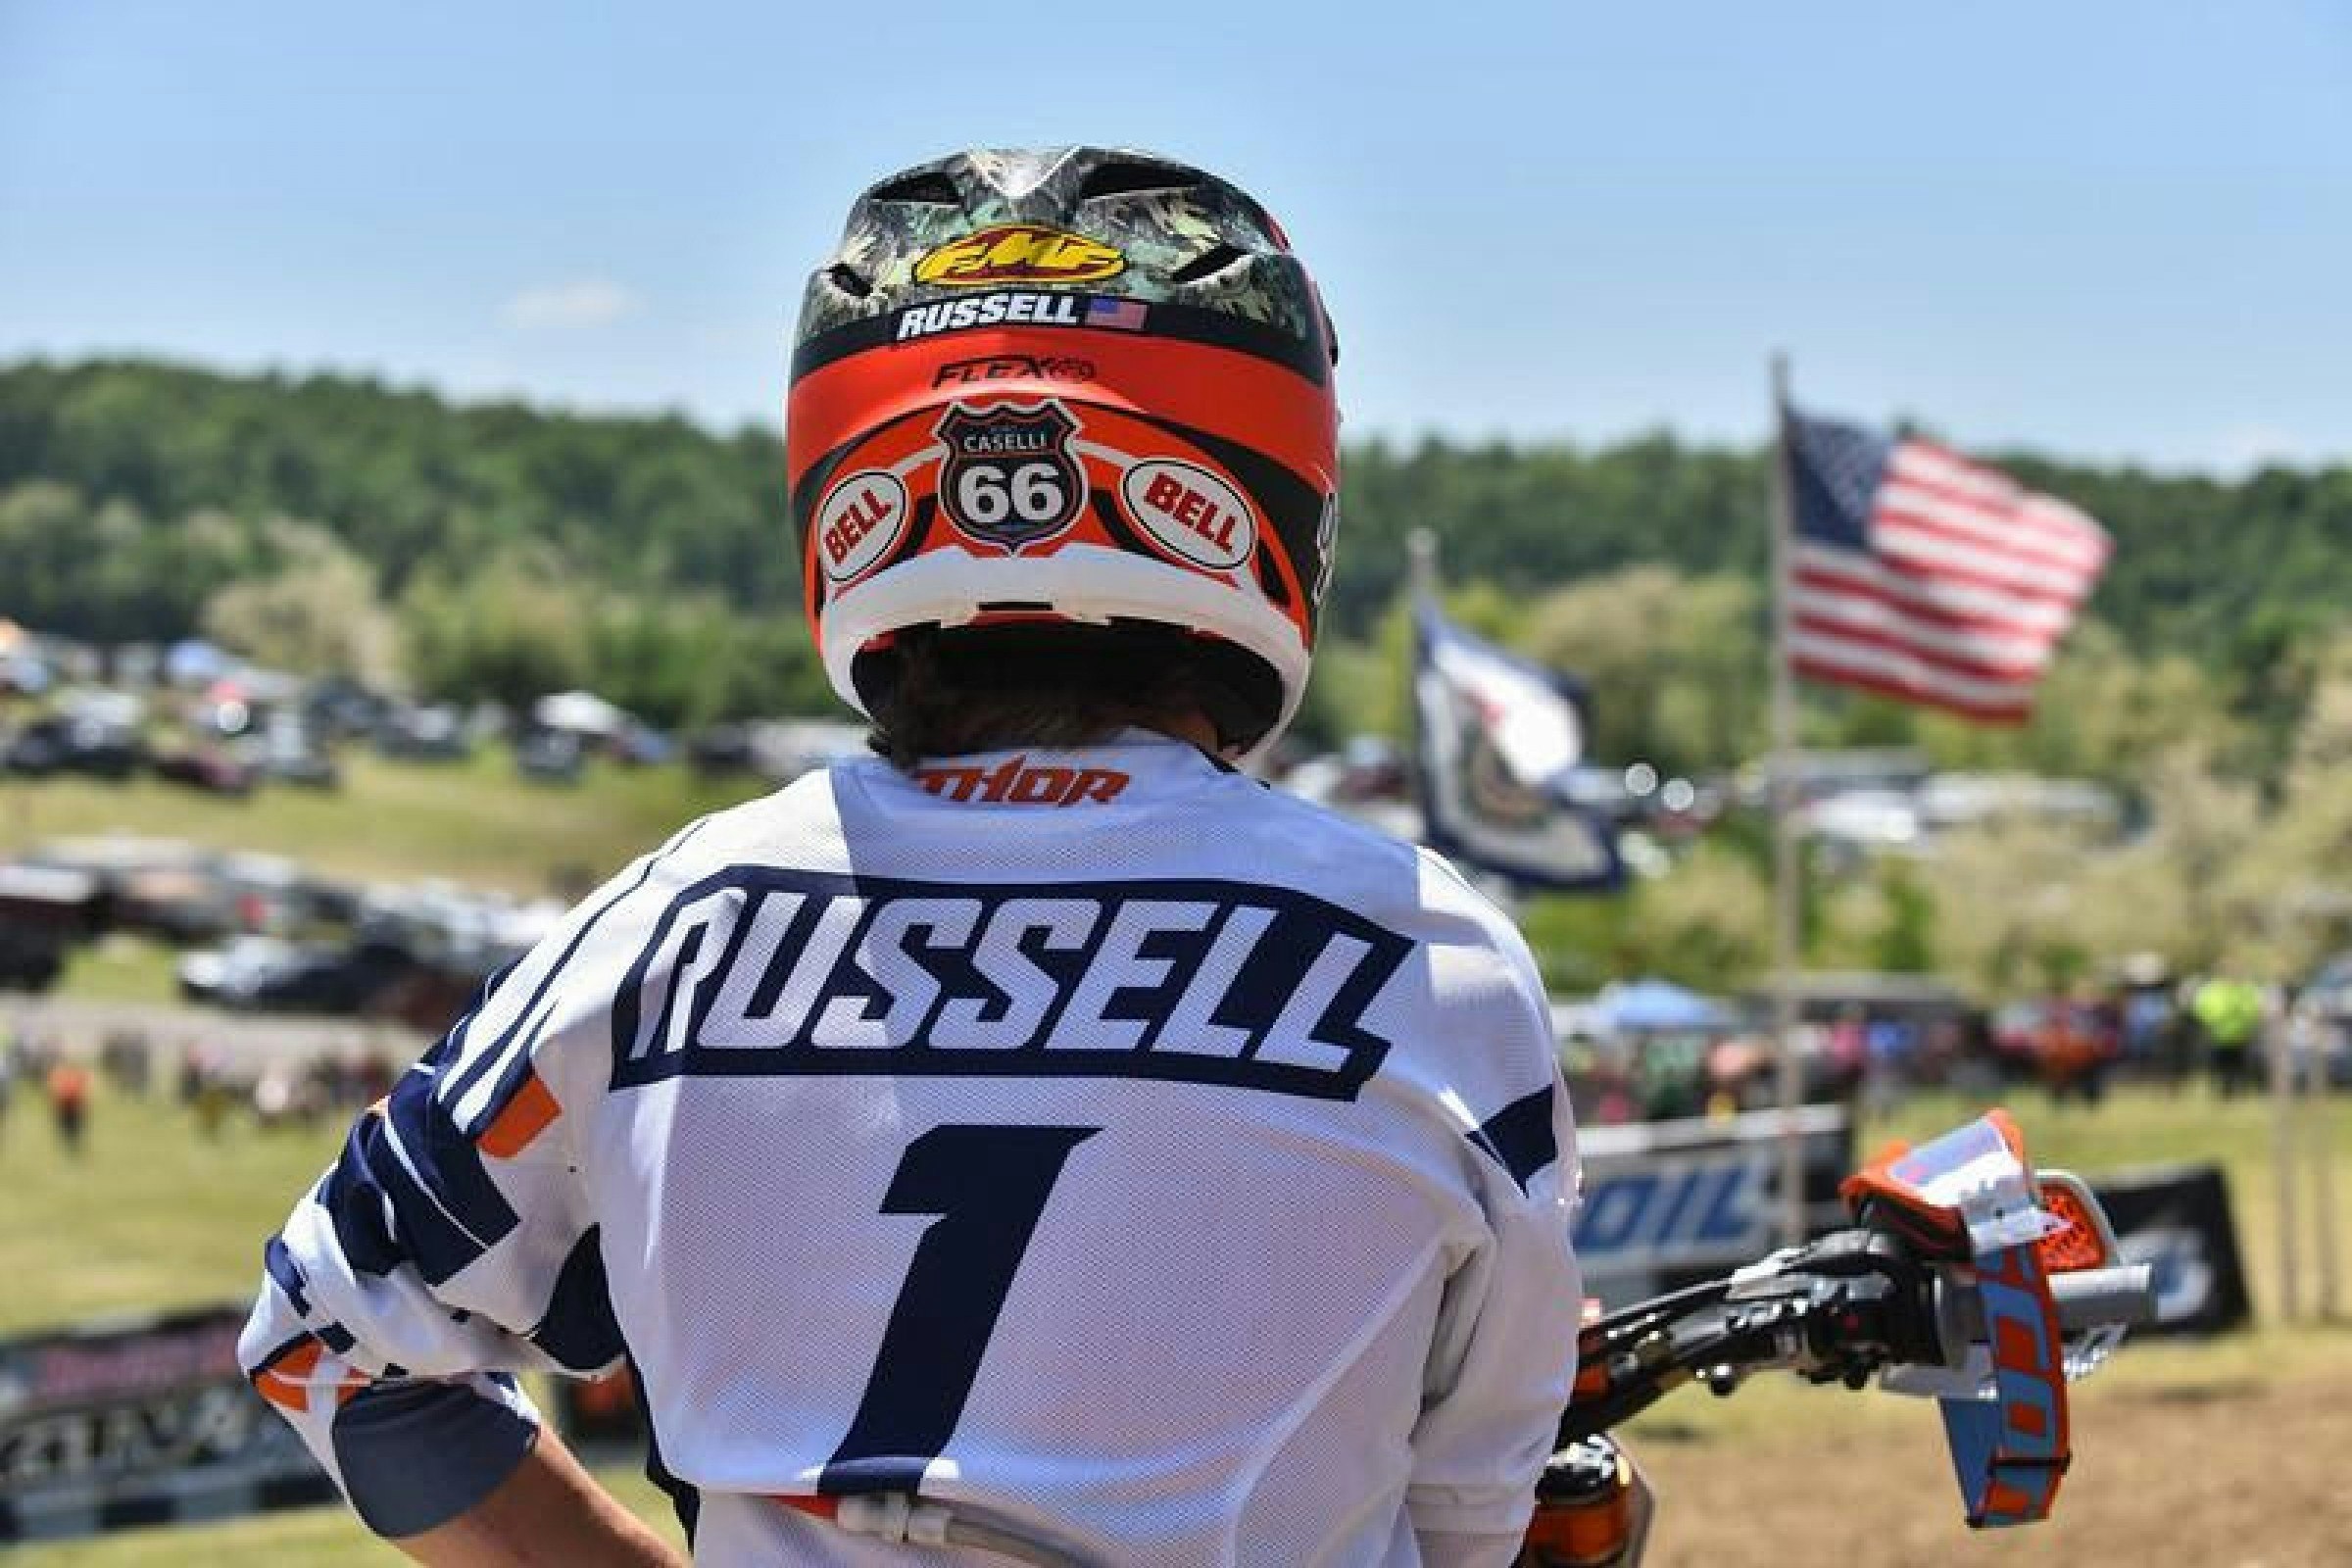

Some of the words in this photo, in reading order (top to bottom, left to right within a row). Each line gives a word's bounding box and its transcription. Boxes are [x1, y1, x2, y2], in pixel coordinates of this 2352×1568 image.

[896, 293, 1079, 341] RUSSELL
[963, 431, 1048, 452] CASELLI
[957, 463, 1065, 523] 66
[1143, 470, 1238, 554] BELL
[825, 489, 893, 566] BELL
[911, 752, 1132, 808] THOR
[627, 886, 1374, 1074] RUSSELL
[816, 1123, 1104, 1496] 1
